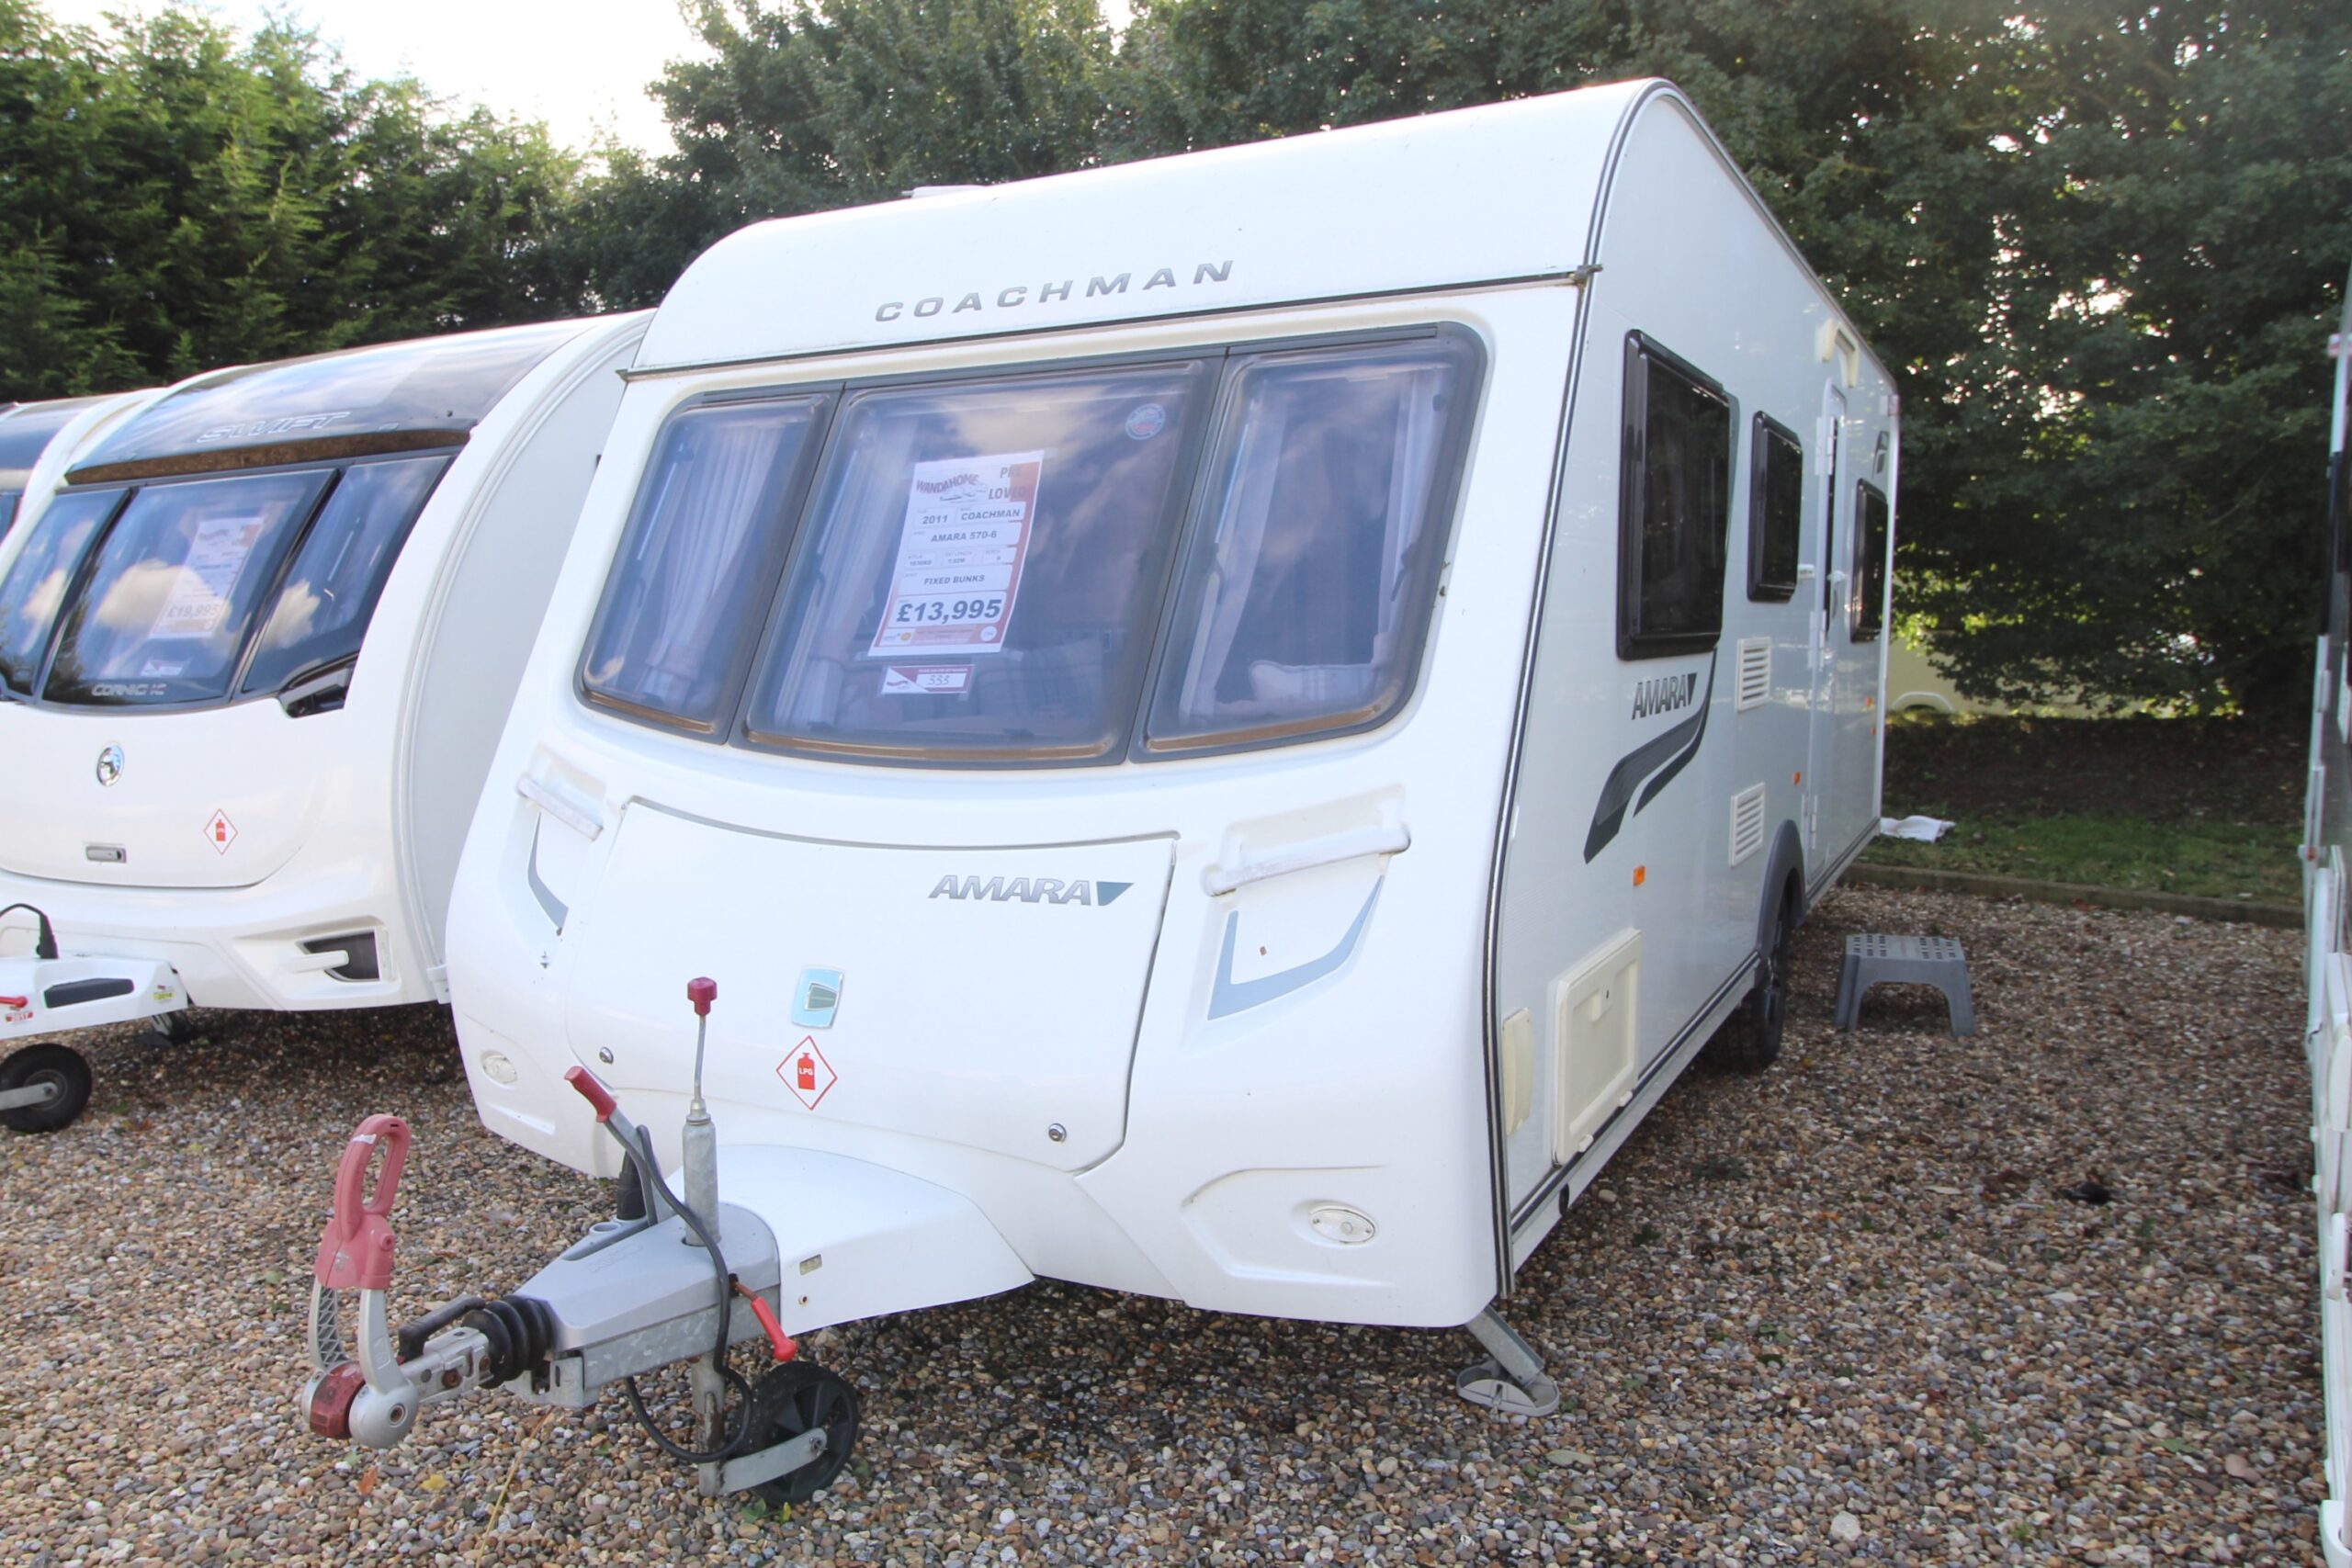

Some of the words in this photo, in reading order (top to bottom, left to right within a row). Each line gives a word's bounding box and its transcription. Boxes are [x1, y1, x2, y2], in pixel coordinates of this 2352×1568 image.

[875, 260, 1233, 321] COACHMAN
[197, 412, 351, 443] SWIFT
[916, 473, 979, 494] WANDAHOME
[922, 514, 948, 525] 2011
[961, 509, 1021, 521] COACHMAN
[931, 533, 967, 543] AMARA
[923, 577, 951, 586] FIXED
[953, 574, 985, 584] BUNKS
[167, 604, 220, 619] £19,995
[896, 599, 1002, 624] £13,995
[1632, 673, 1688, 720] AMARA
[927, 874, 1091, 906] AMARA
[798, 1066, 814, 1077] LPG
